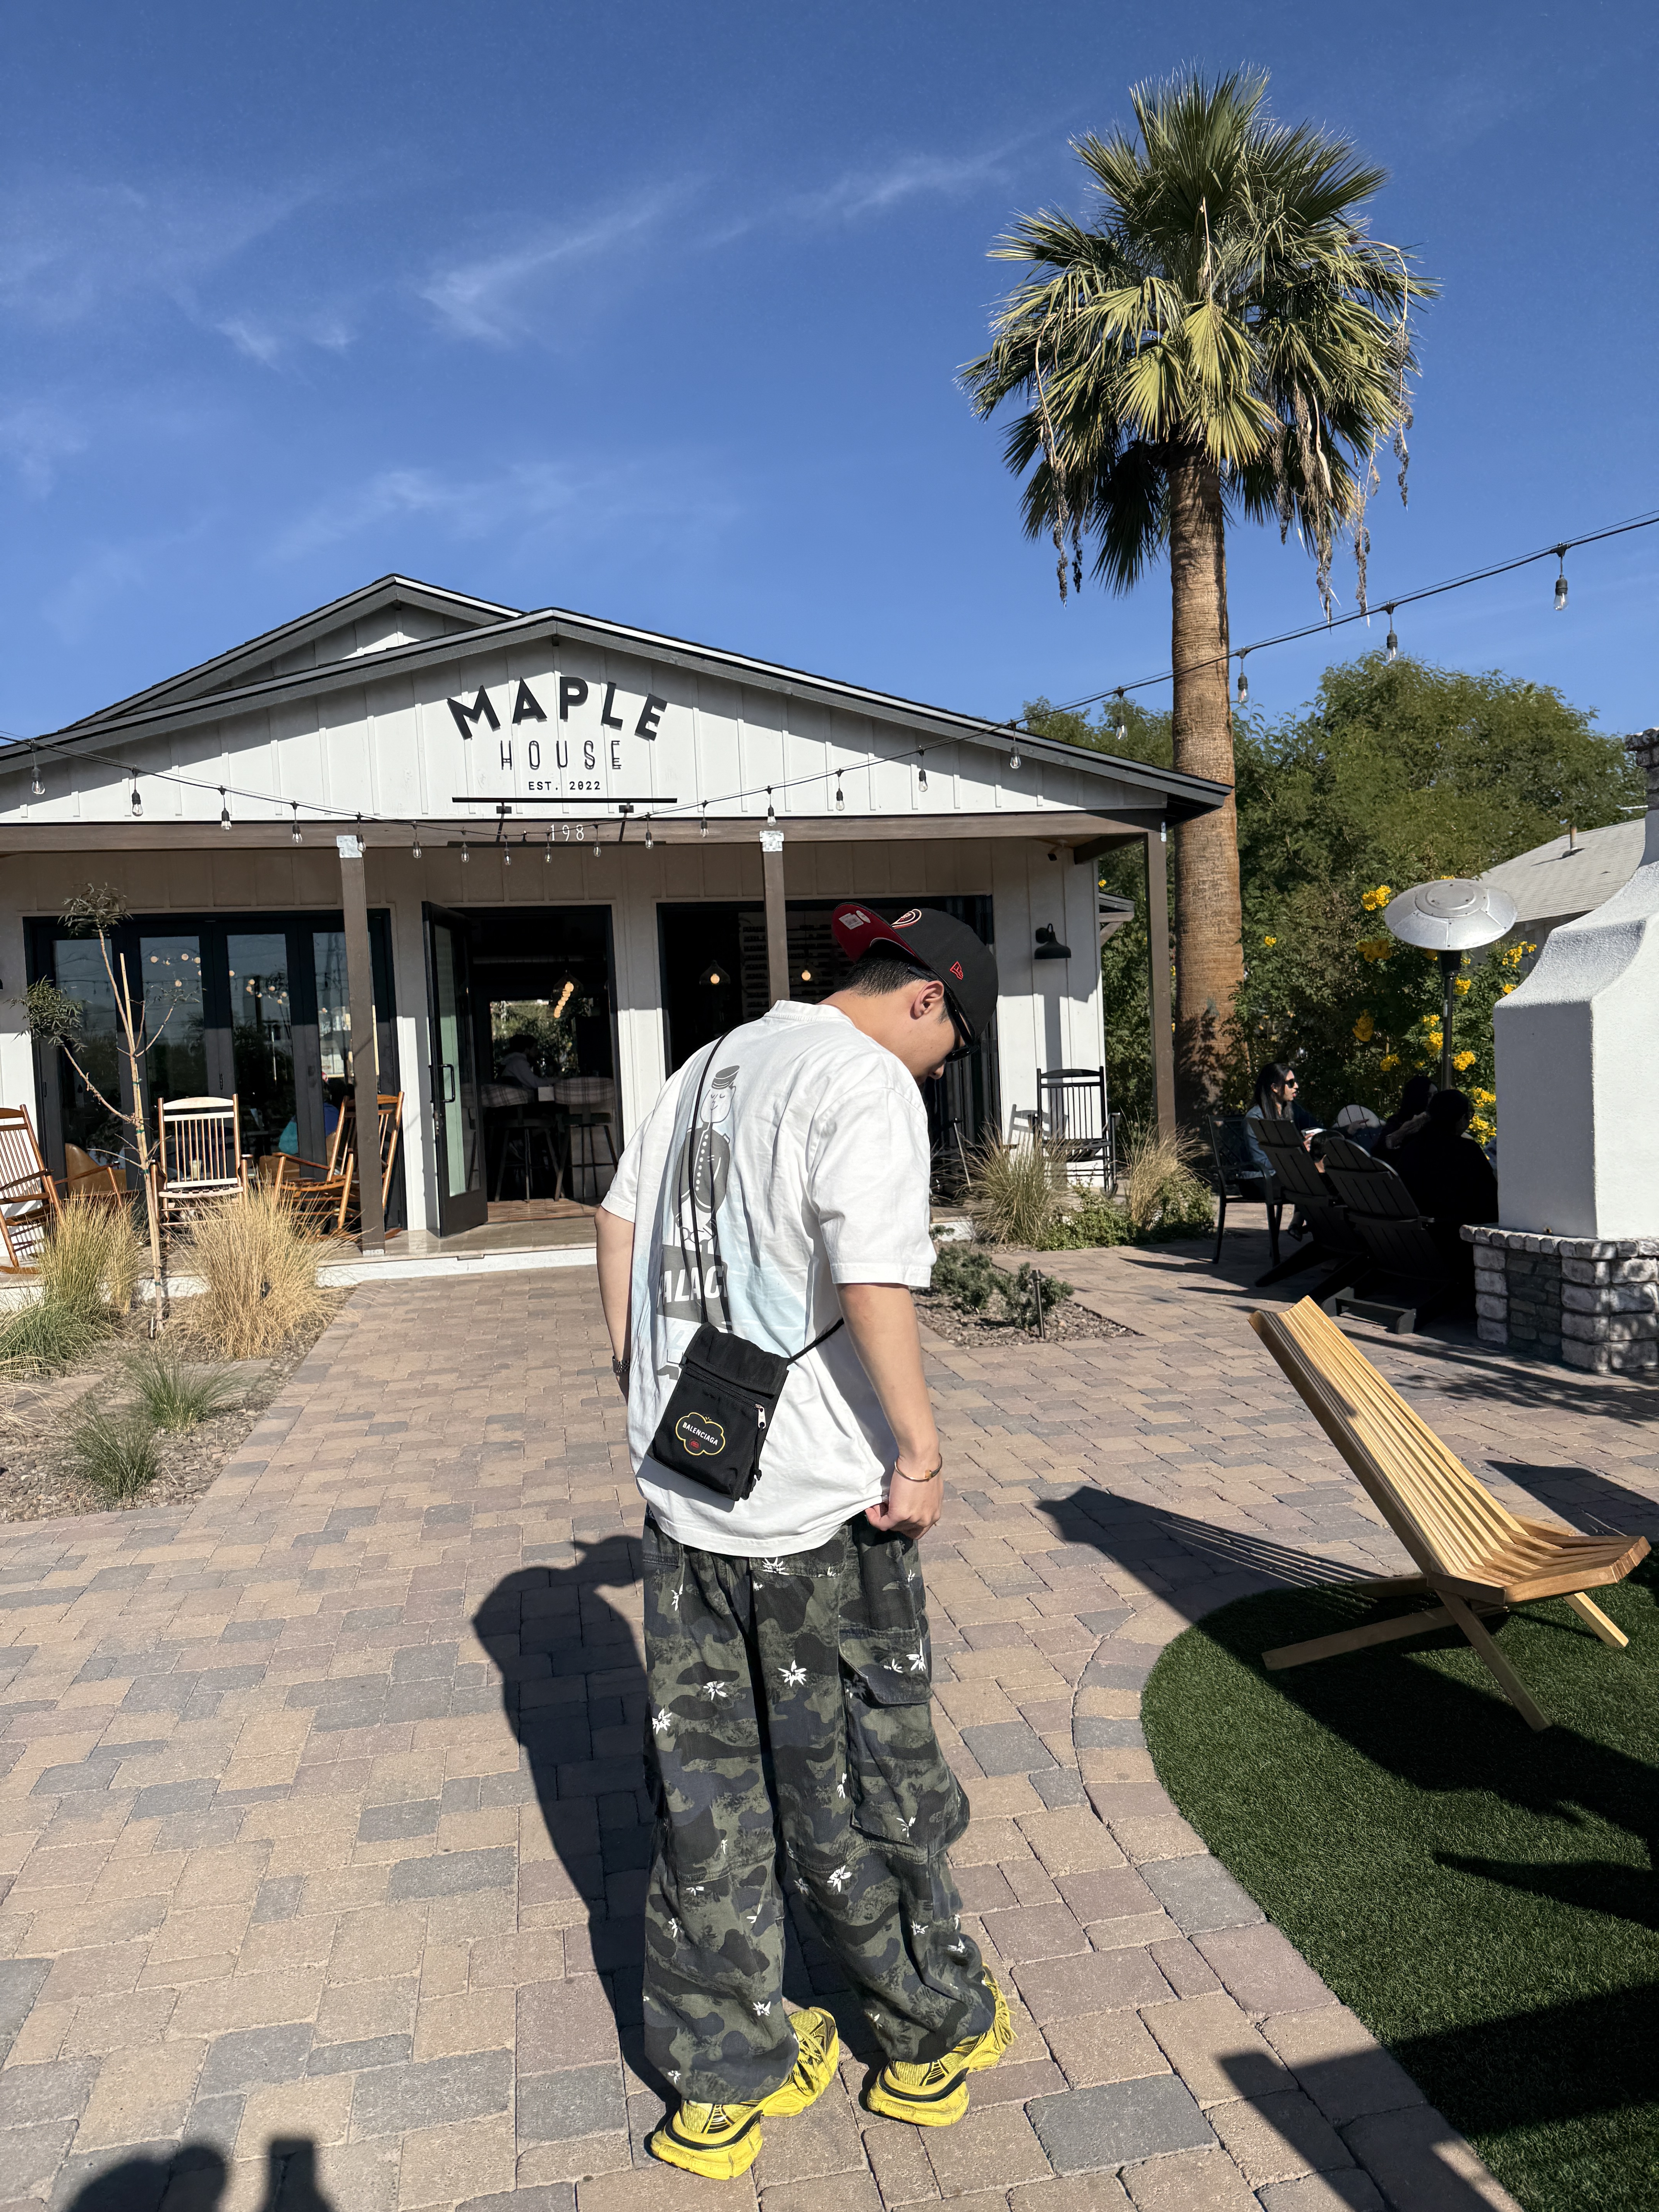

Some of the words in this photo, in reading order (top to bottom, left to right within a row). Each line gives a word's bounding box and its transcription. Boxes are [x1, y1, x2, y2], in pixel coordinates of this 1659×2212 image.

[447, 676, 668, 740] MAPLE
[500, 740, 622, 770] HOUSE
[528, 781, 558, 790] EST.
[569, 781, 601, 790] 2022
[550, 824, 585, 842] 198
[657, 1265, 727, 1308] ALAC
[682, 1422, 718, 1446] BALENCIAGA
